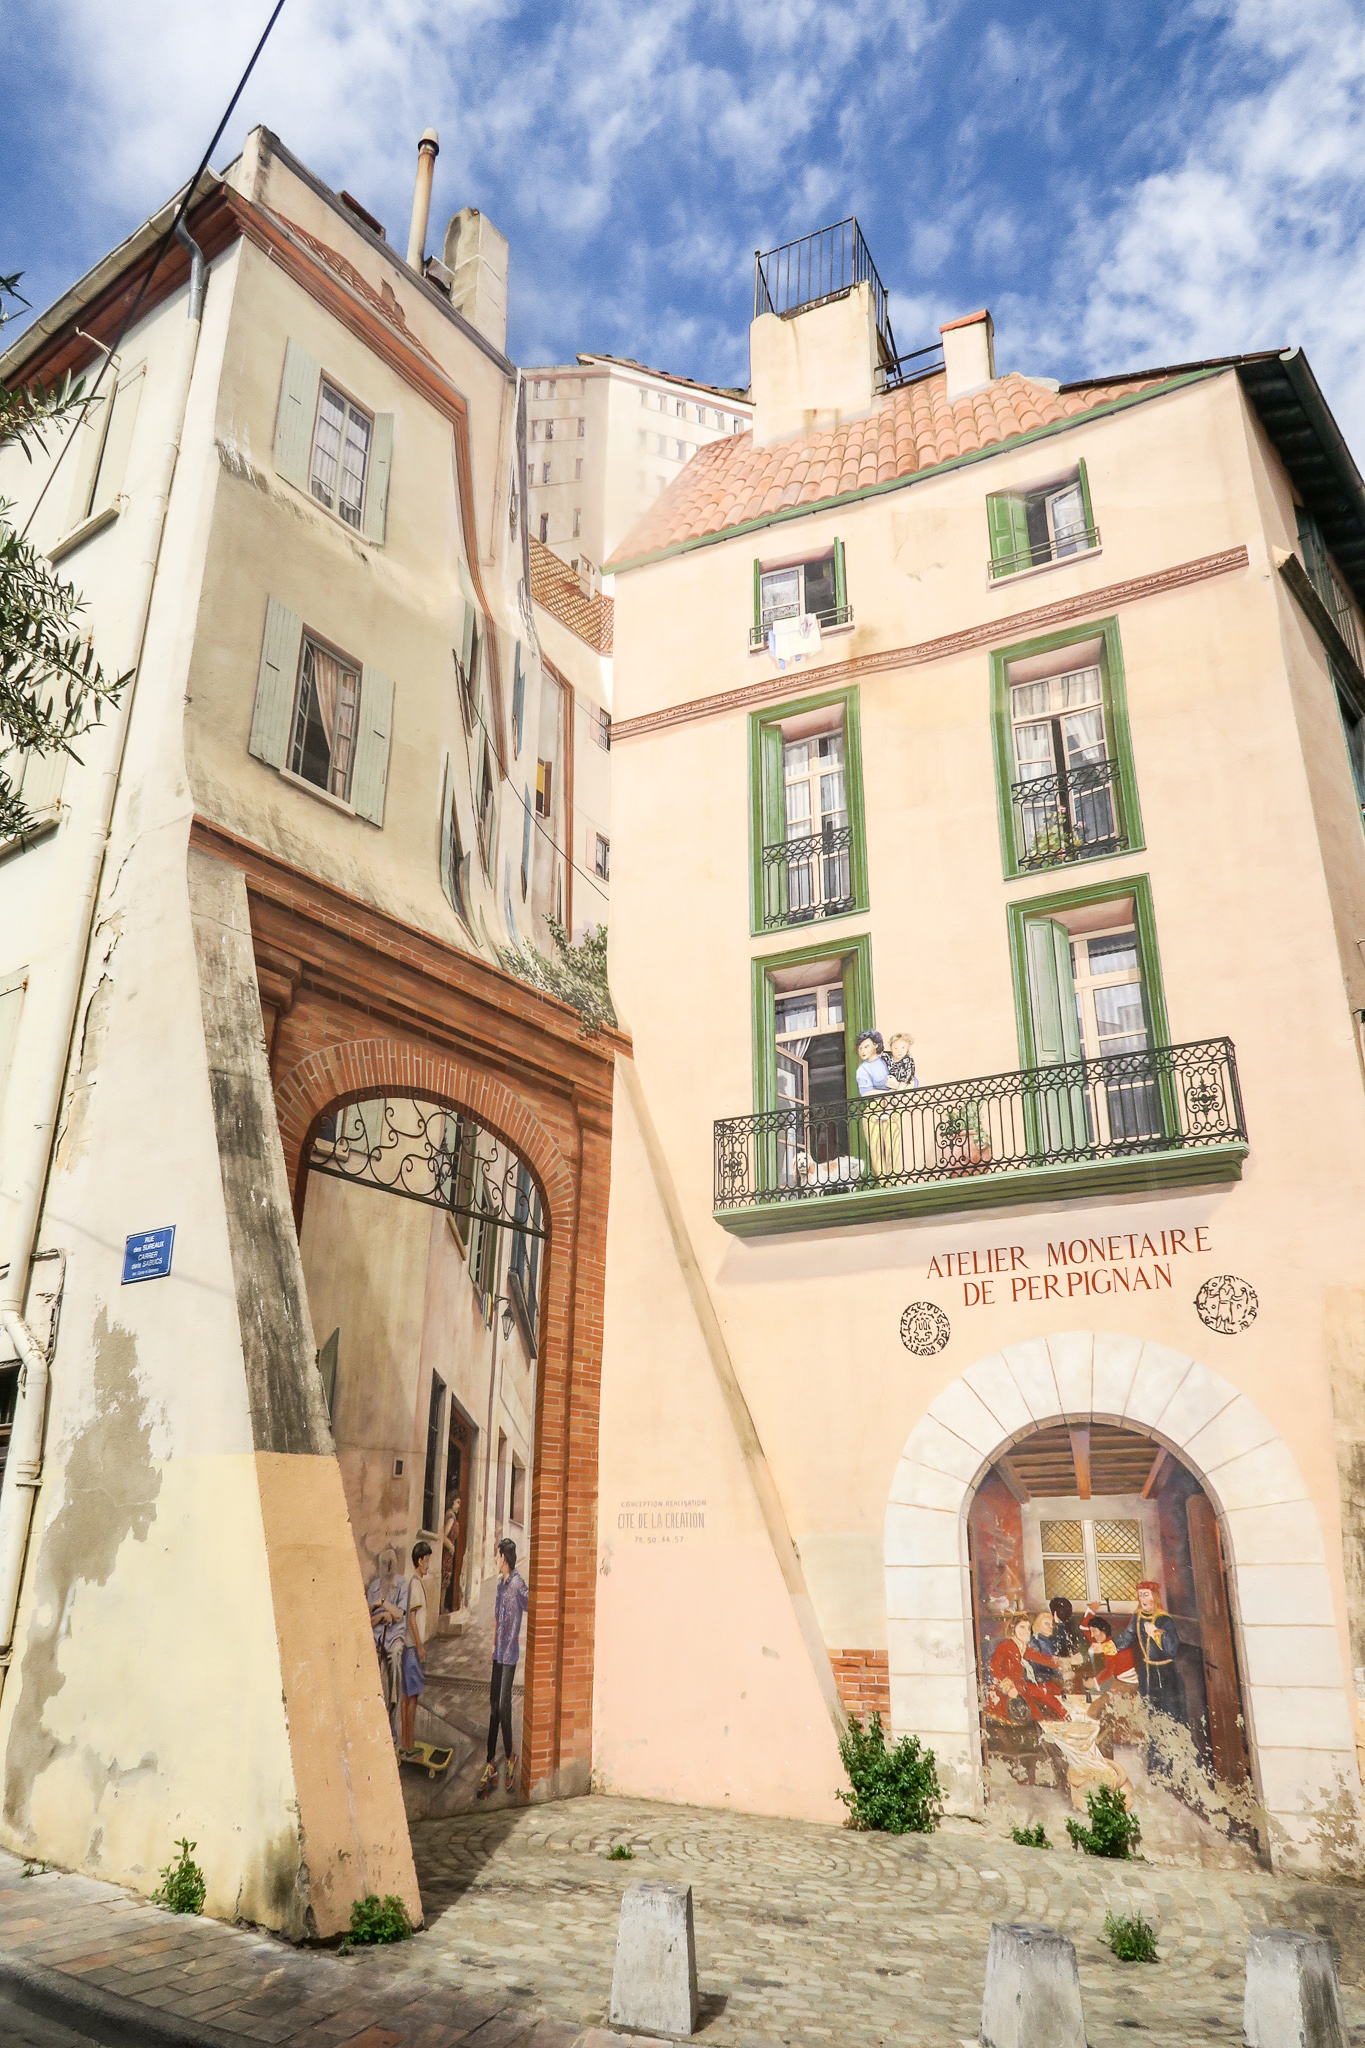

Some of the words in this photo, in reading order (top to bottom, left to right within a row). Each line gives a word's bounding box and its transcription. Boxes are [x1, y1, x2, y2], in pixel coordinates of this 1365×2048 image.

[144, 1235, 155, 1243] RUE
[143, 1241, 165, 1251] SUREAUX
[926, 1245, 1031, 1279] ATELIER
[1047, 1226, 1212, 1267] MONETAIRE
[137, 1251, 159, 1261] CARRER
[963, 1280, 996, 1307] DE
[1011, 1263, 1173, 1303] PERPIGNAN
[617, 1513, 635, 1529] CITE
[638, 1512, 648, 1529] DE
[651, 1512, 663, 1529] LA
[665, 1512, 705, 1529] CREATION
